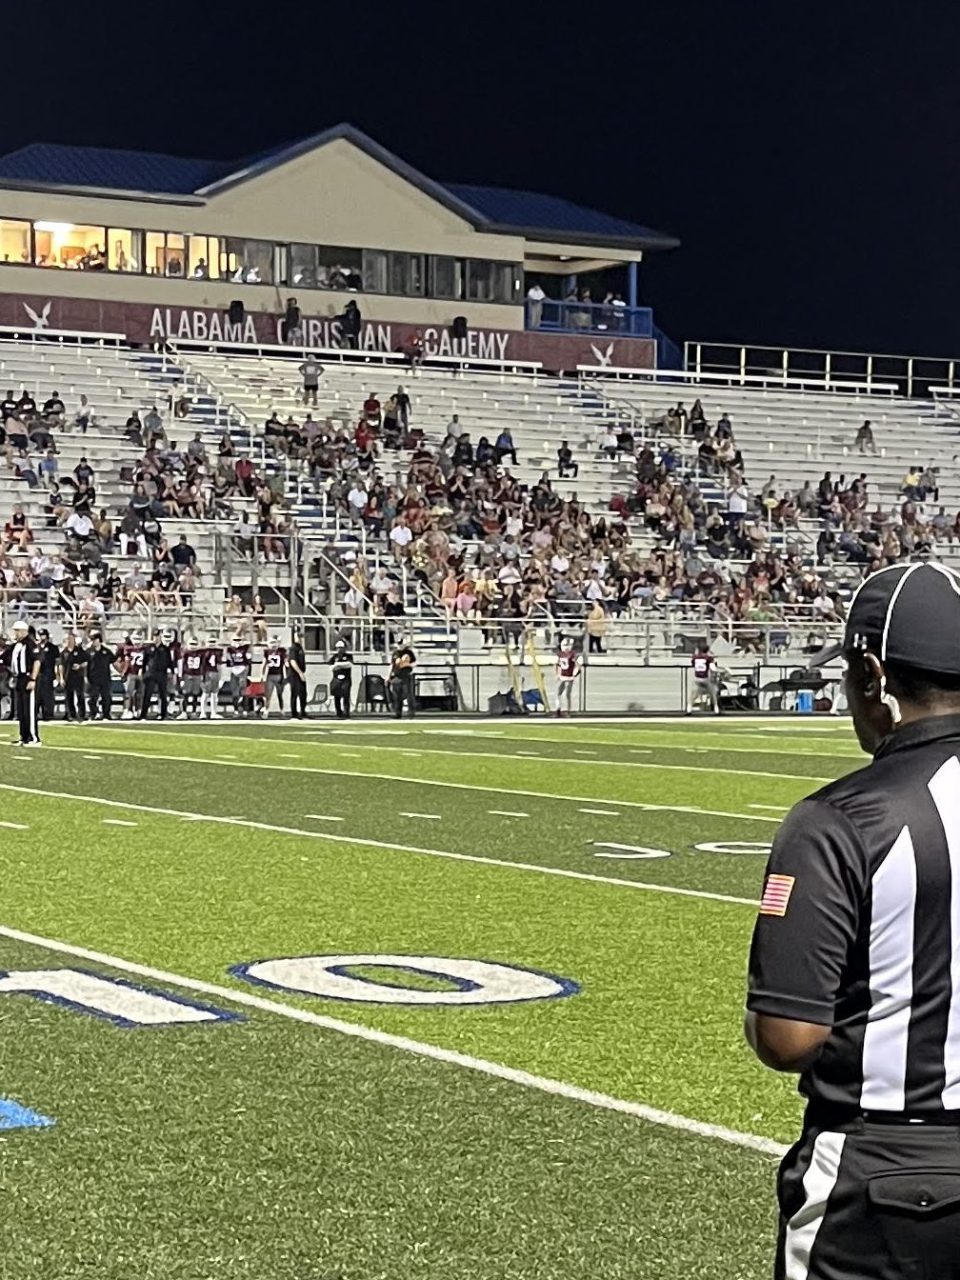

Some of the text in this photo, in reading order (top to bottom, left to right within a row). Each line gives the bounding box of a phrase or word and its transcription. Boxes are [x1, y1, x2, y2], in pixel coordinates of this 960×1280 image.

[150, 308, 509, 360] ALABAMA CRISIAN CADEMY
